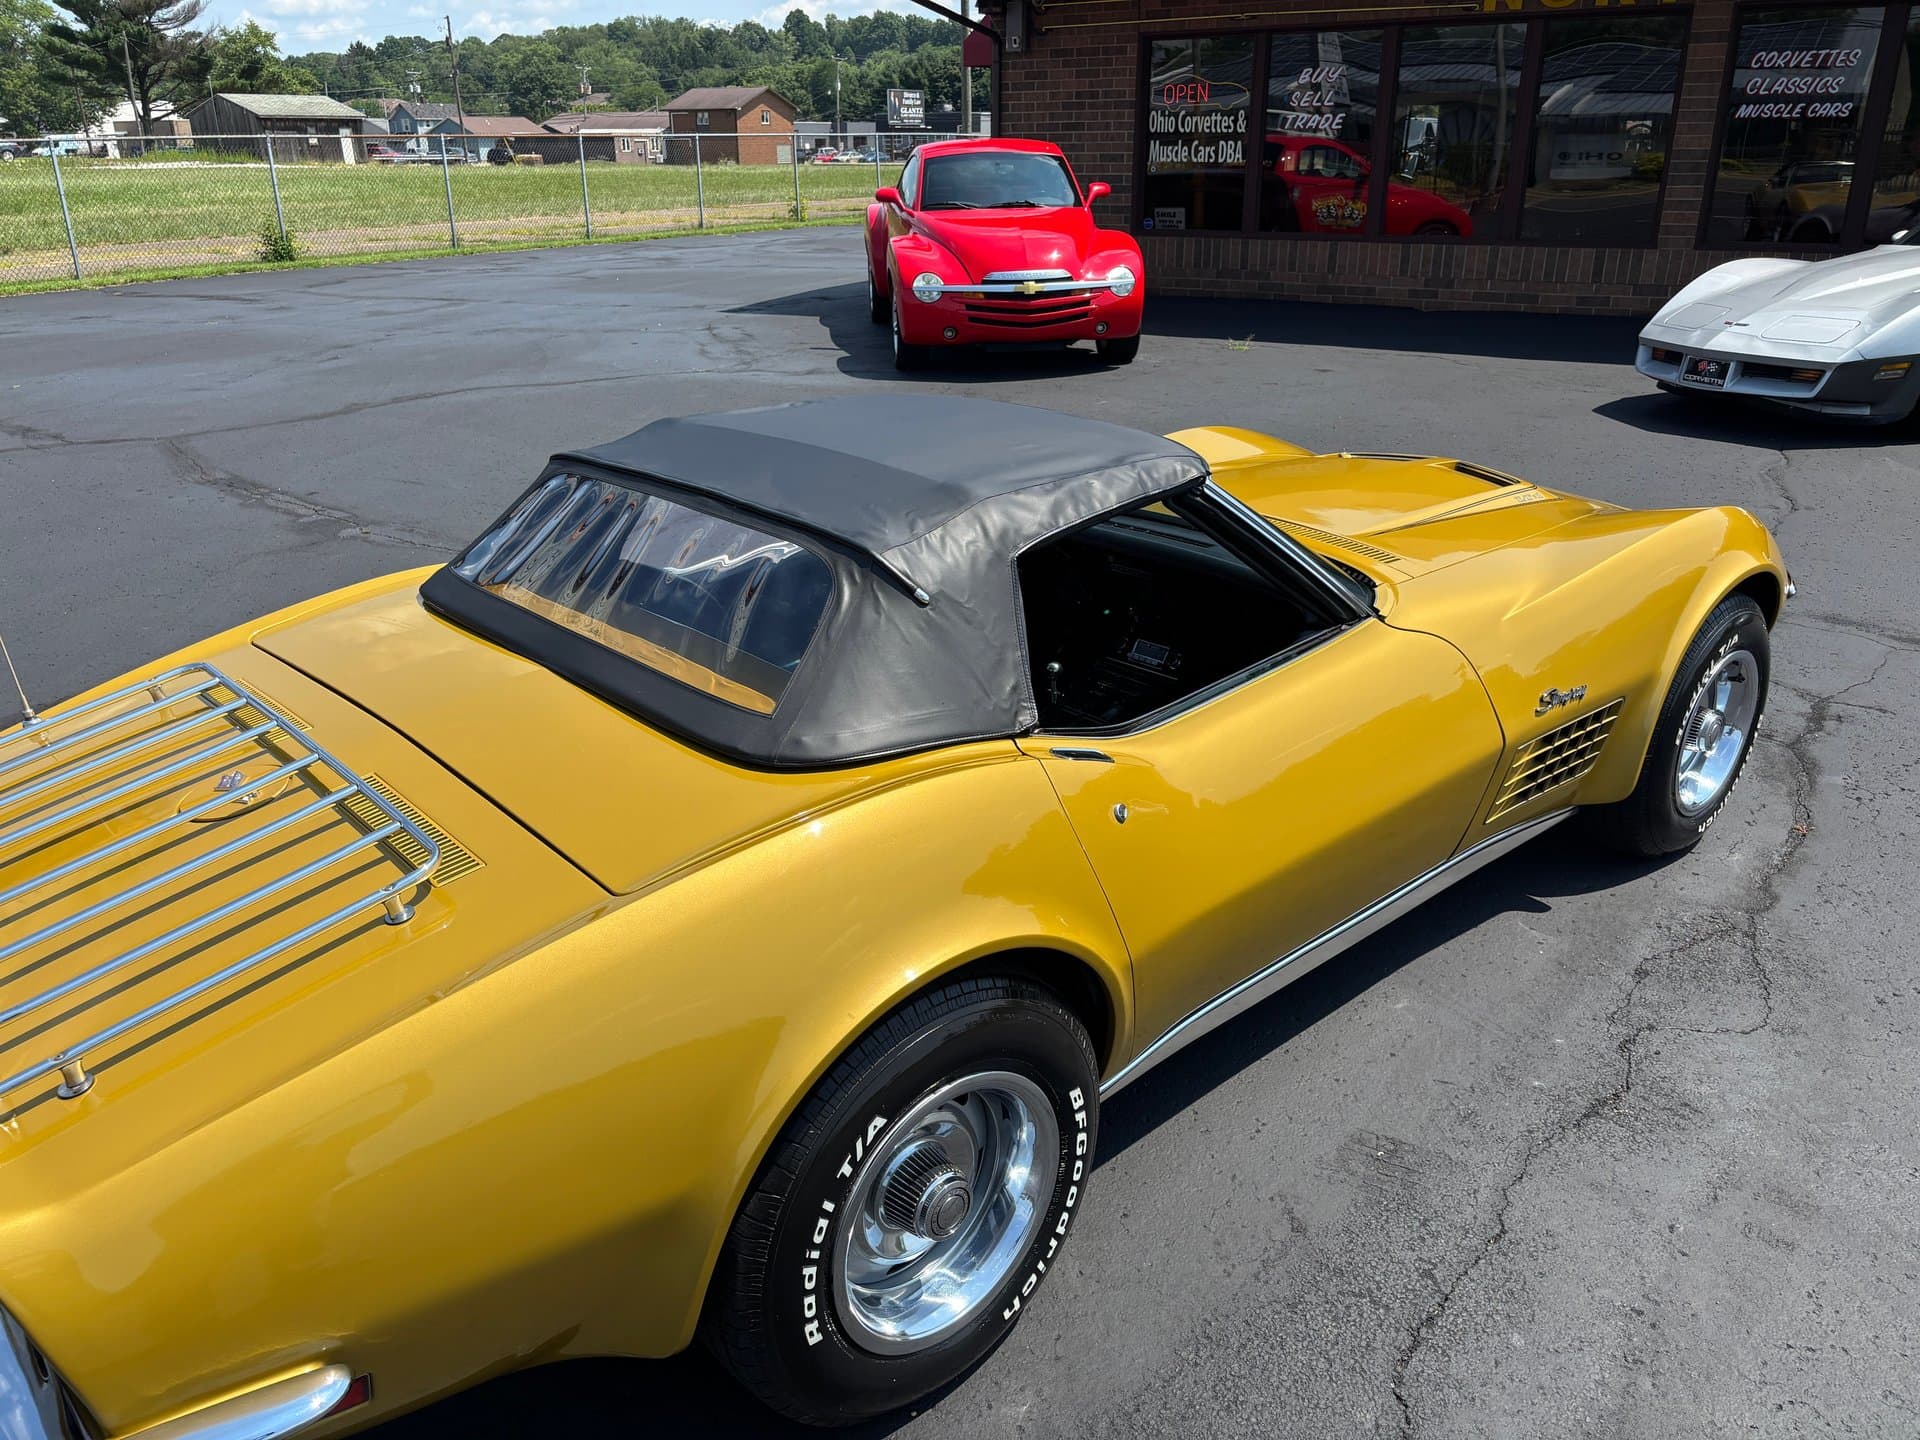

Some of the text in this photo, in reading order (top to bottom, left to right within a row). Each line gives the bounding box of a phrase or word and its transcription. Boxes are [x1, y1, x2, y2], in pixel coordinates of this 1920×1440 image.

[1751, 49, 1861, 68] CORVETTES
[1298, 66, 1344, 84] BUY
[1163, 81, 1209, 104] OPEN
[1746, 77, 1845, 94] CLASSICS
[1289, 90, 1335, 107] SELL
[1735, 102, 1853, 118] MUSCLE CARS
[1149, 109, 1247, 133] Ohio Corvettes &
[1284, 113, 1346, 129] TRADE
[1148, 140, 1189, 163] Muscle
[1190, 140, 1216, 163] Cars
[1683, 373, 1725, 386] CORVETTE
[1002, 1087, 1087, 1321] BFGoodrich
[802, 1115, 888, 1347] Radial T/A
